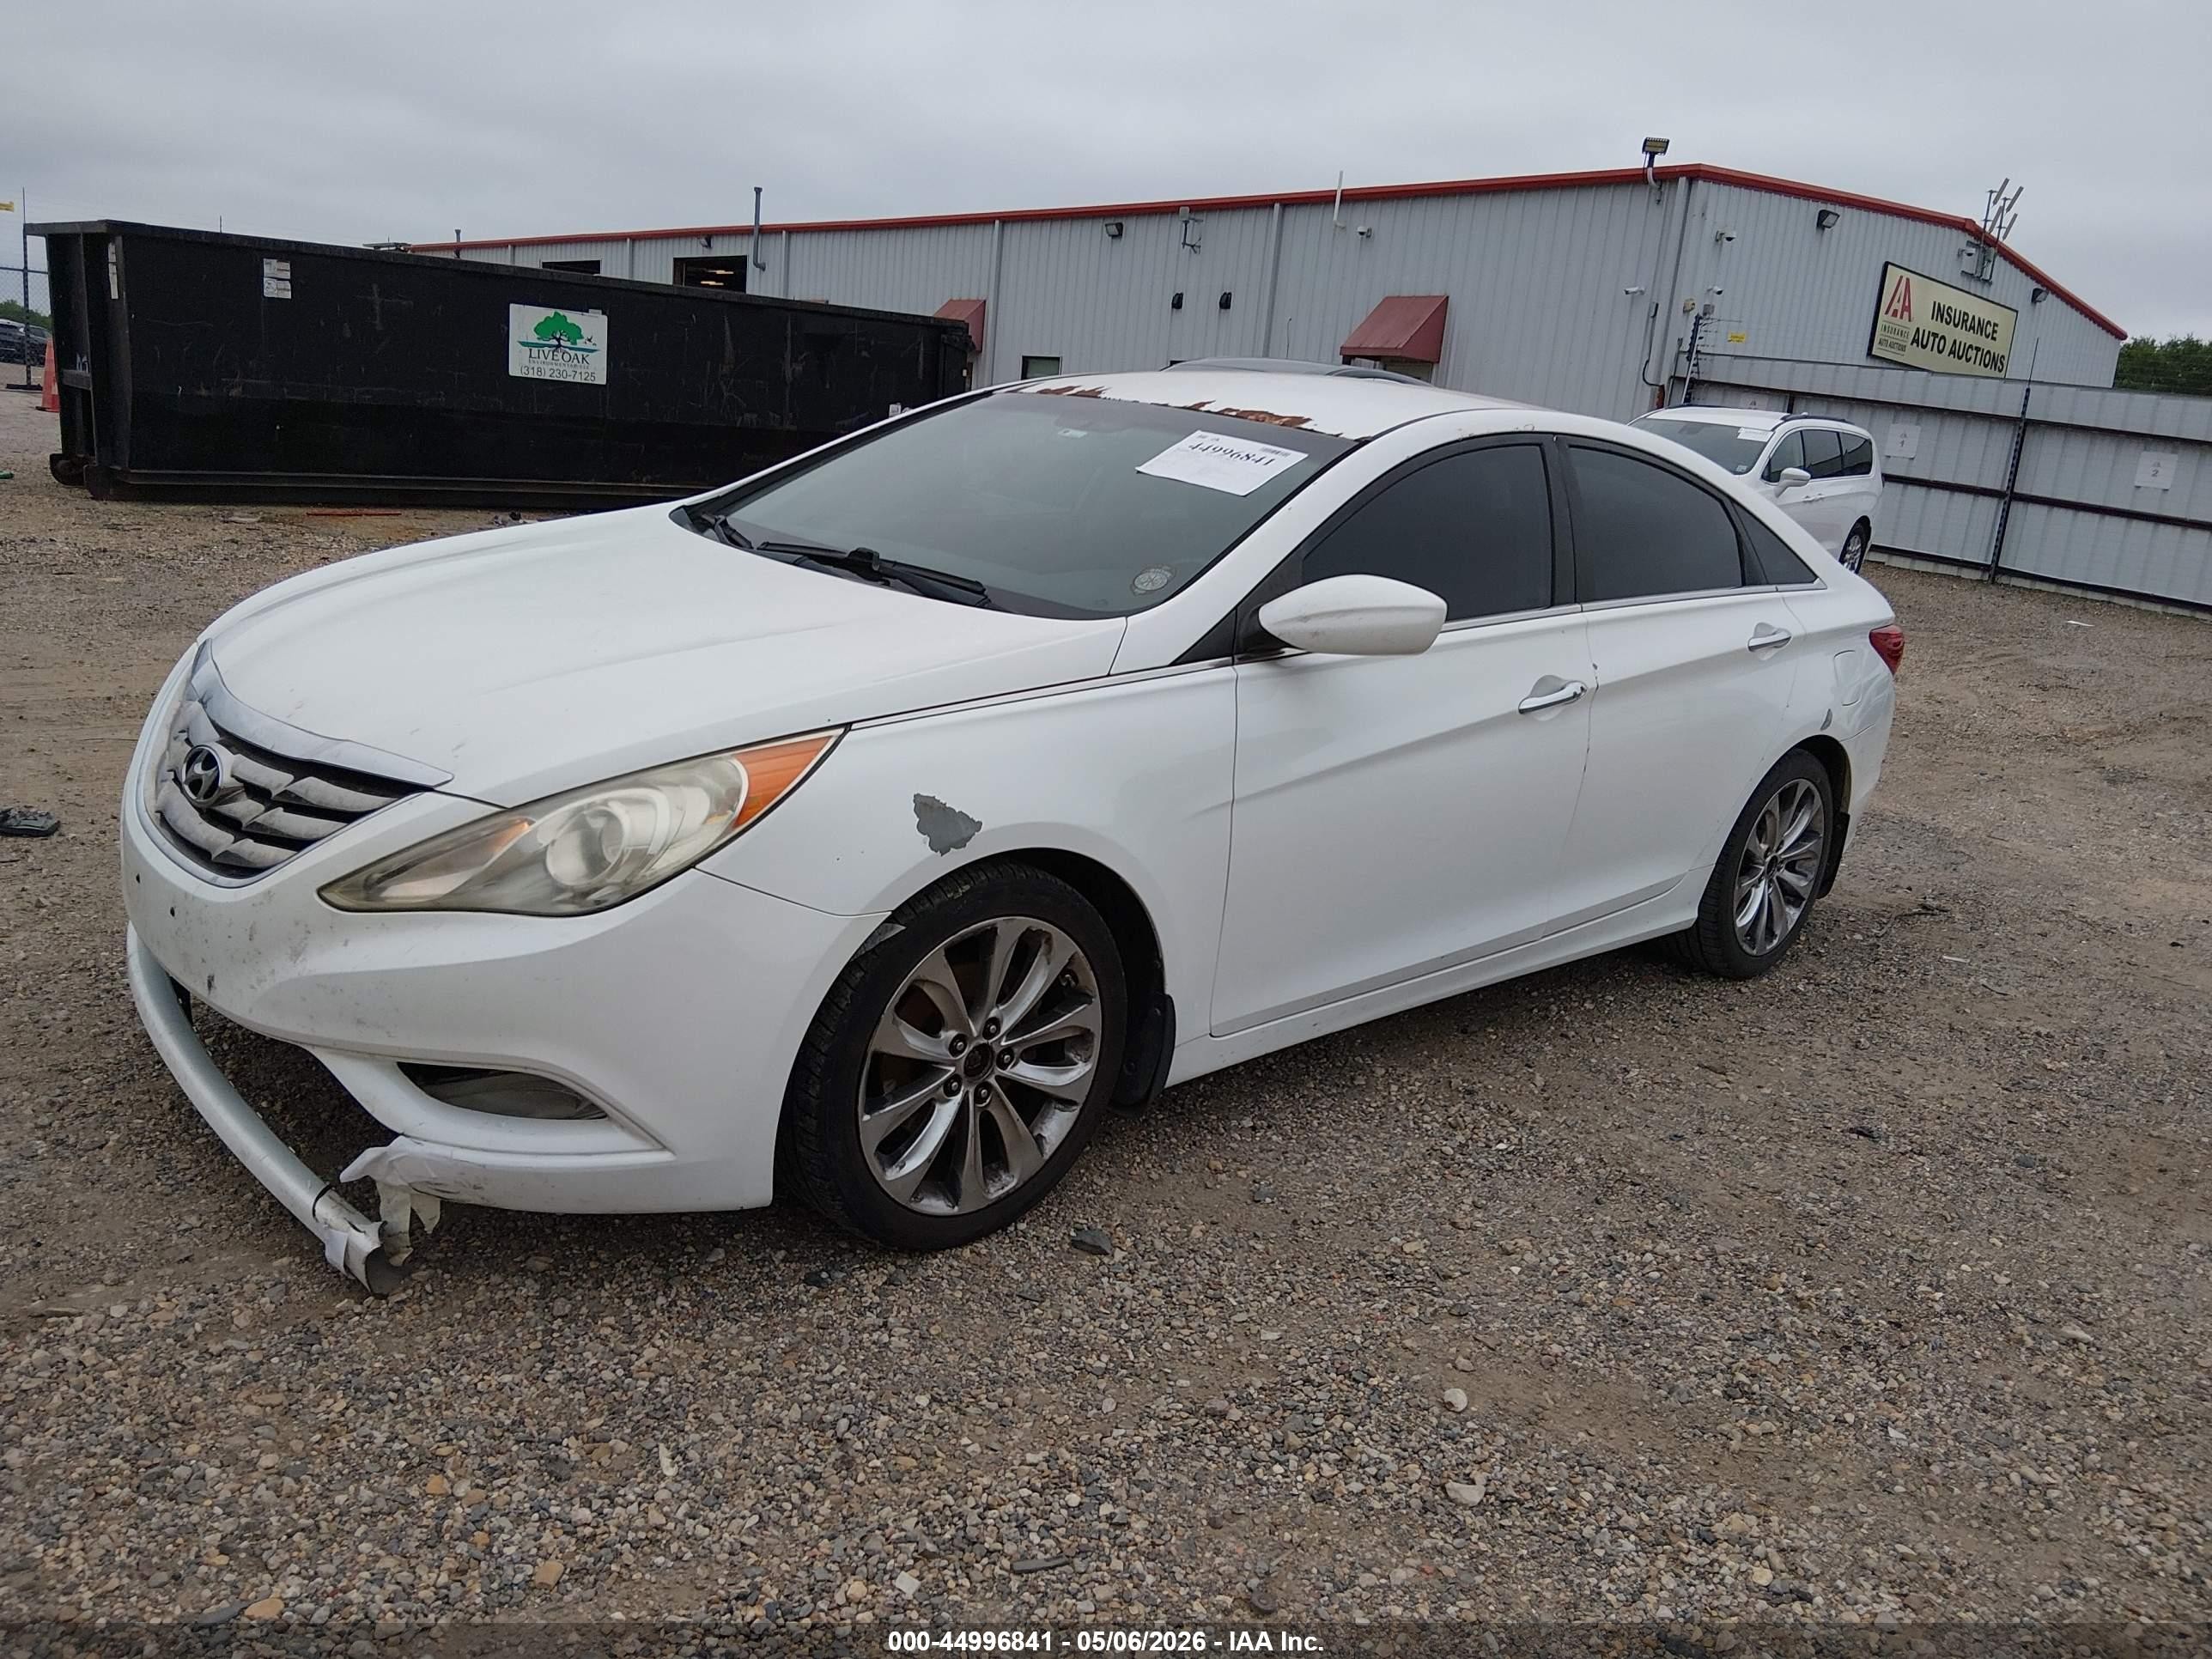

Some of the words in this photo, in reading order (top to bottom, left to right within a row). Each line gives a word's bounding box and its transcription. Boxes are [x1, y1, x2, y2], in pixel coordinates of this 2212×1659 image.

[1930, 301, 1999, 342] INSURANCE
[528, 348, 560, 362] LIVE
[561, 351, 591, 365] OAK
[1910, 326, 1948, 355] AUTO
[1948, 338, 2006, 374] AUCTIONS
[520, 365, 546, 377] (318)
[549, 368, 596, 382] 230-7125
[1188, 442, 1276, 466] 44996841
